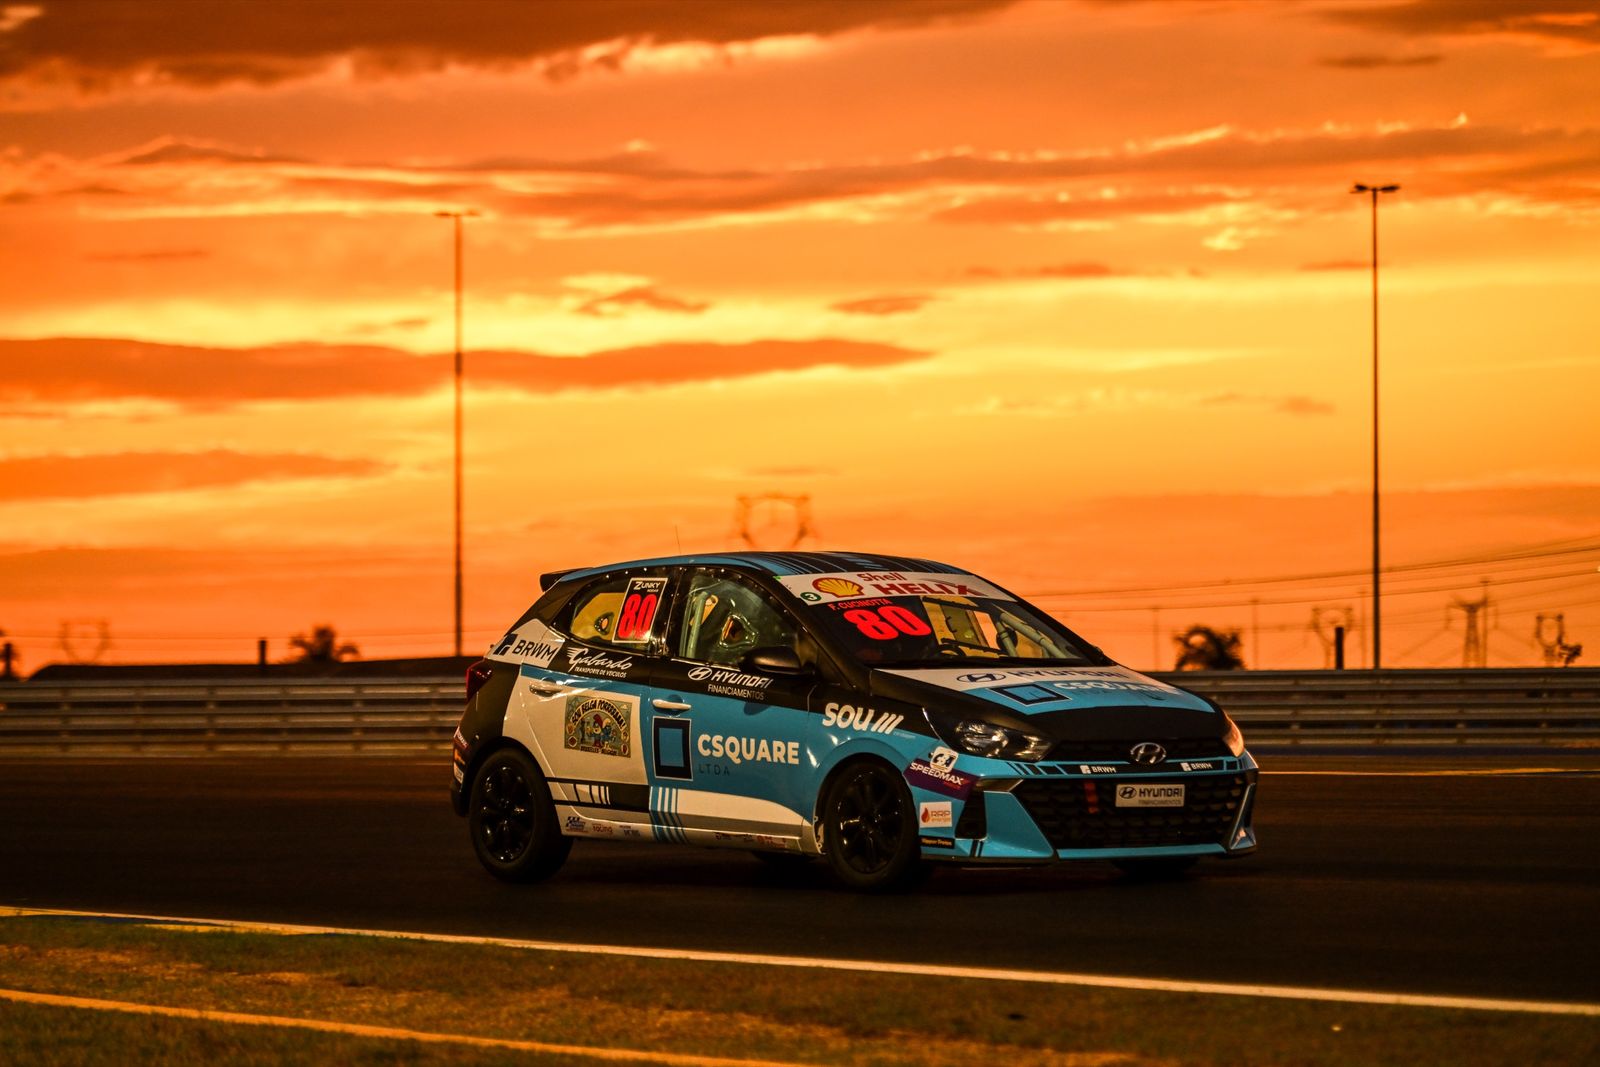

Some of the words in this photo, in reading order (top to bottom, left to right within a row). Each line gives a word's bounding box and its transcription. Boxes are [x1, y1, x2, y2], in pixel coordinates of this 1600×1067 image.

[856, 572, 908, 581] Shell
[633, 581, 661, 590] ZUNKY
[871, 580, 988, 597] HELIX
[618, 593, 657, 640] 80
[843, 605, 932, 641] 80
[512, 639, 559, 663] BRWM
[567, 647, 633, 673] Gabardo
[574, 666, 600, 676] TRANSPORTE
[599, 669, 606, 677] DE
[711, 670, 774, 689] HYUNDAI
[707, 684, 765, 701] FINANCIAMENTOS
[697, 734, 800, 765] CSQUARE
[698, 763, 730, 777] LTDA
[910, 762, 965, 785] SPEEDMAX
[1091, 766, 1117, 774] BRWM
[1190, 762, 1214, 770] BRWM
[1139, 788, 1182, 798] HYUNDAI
